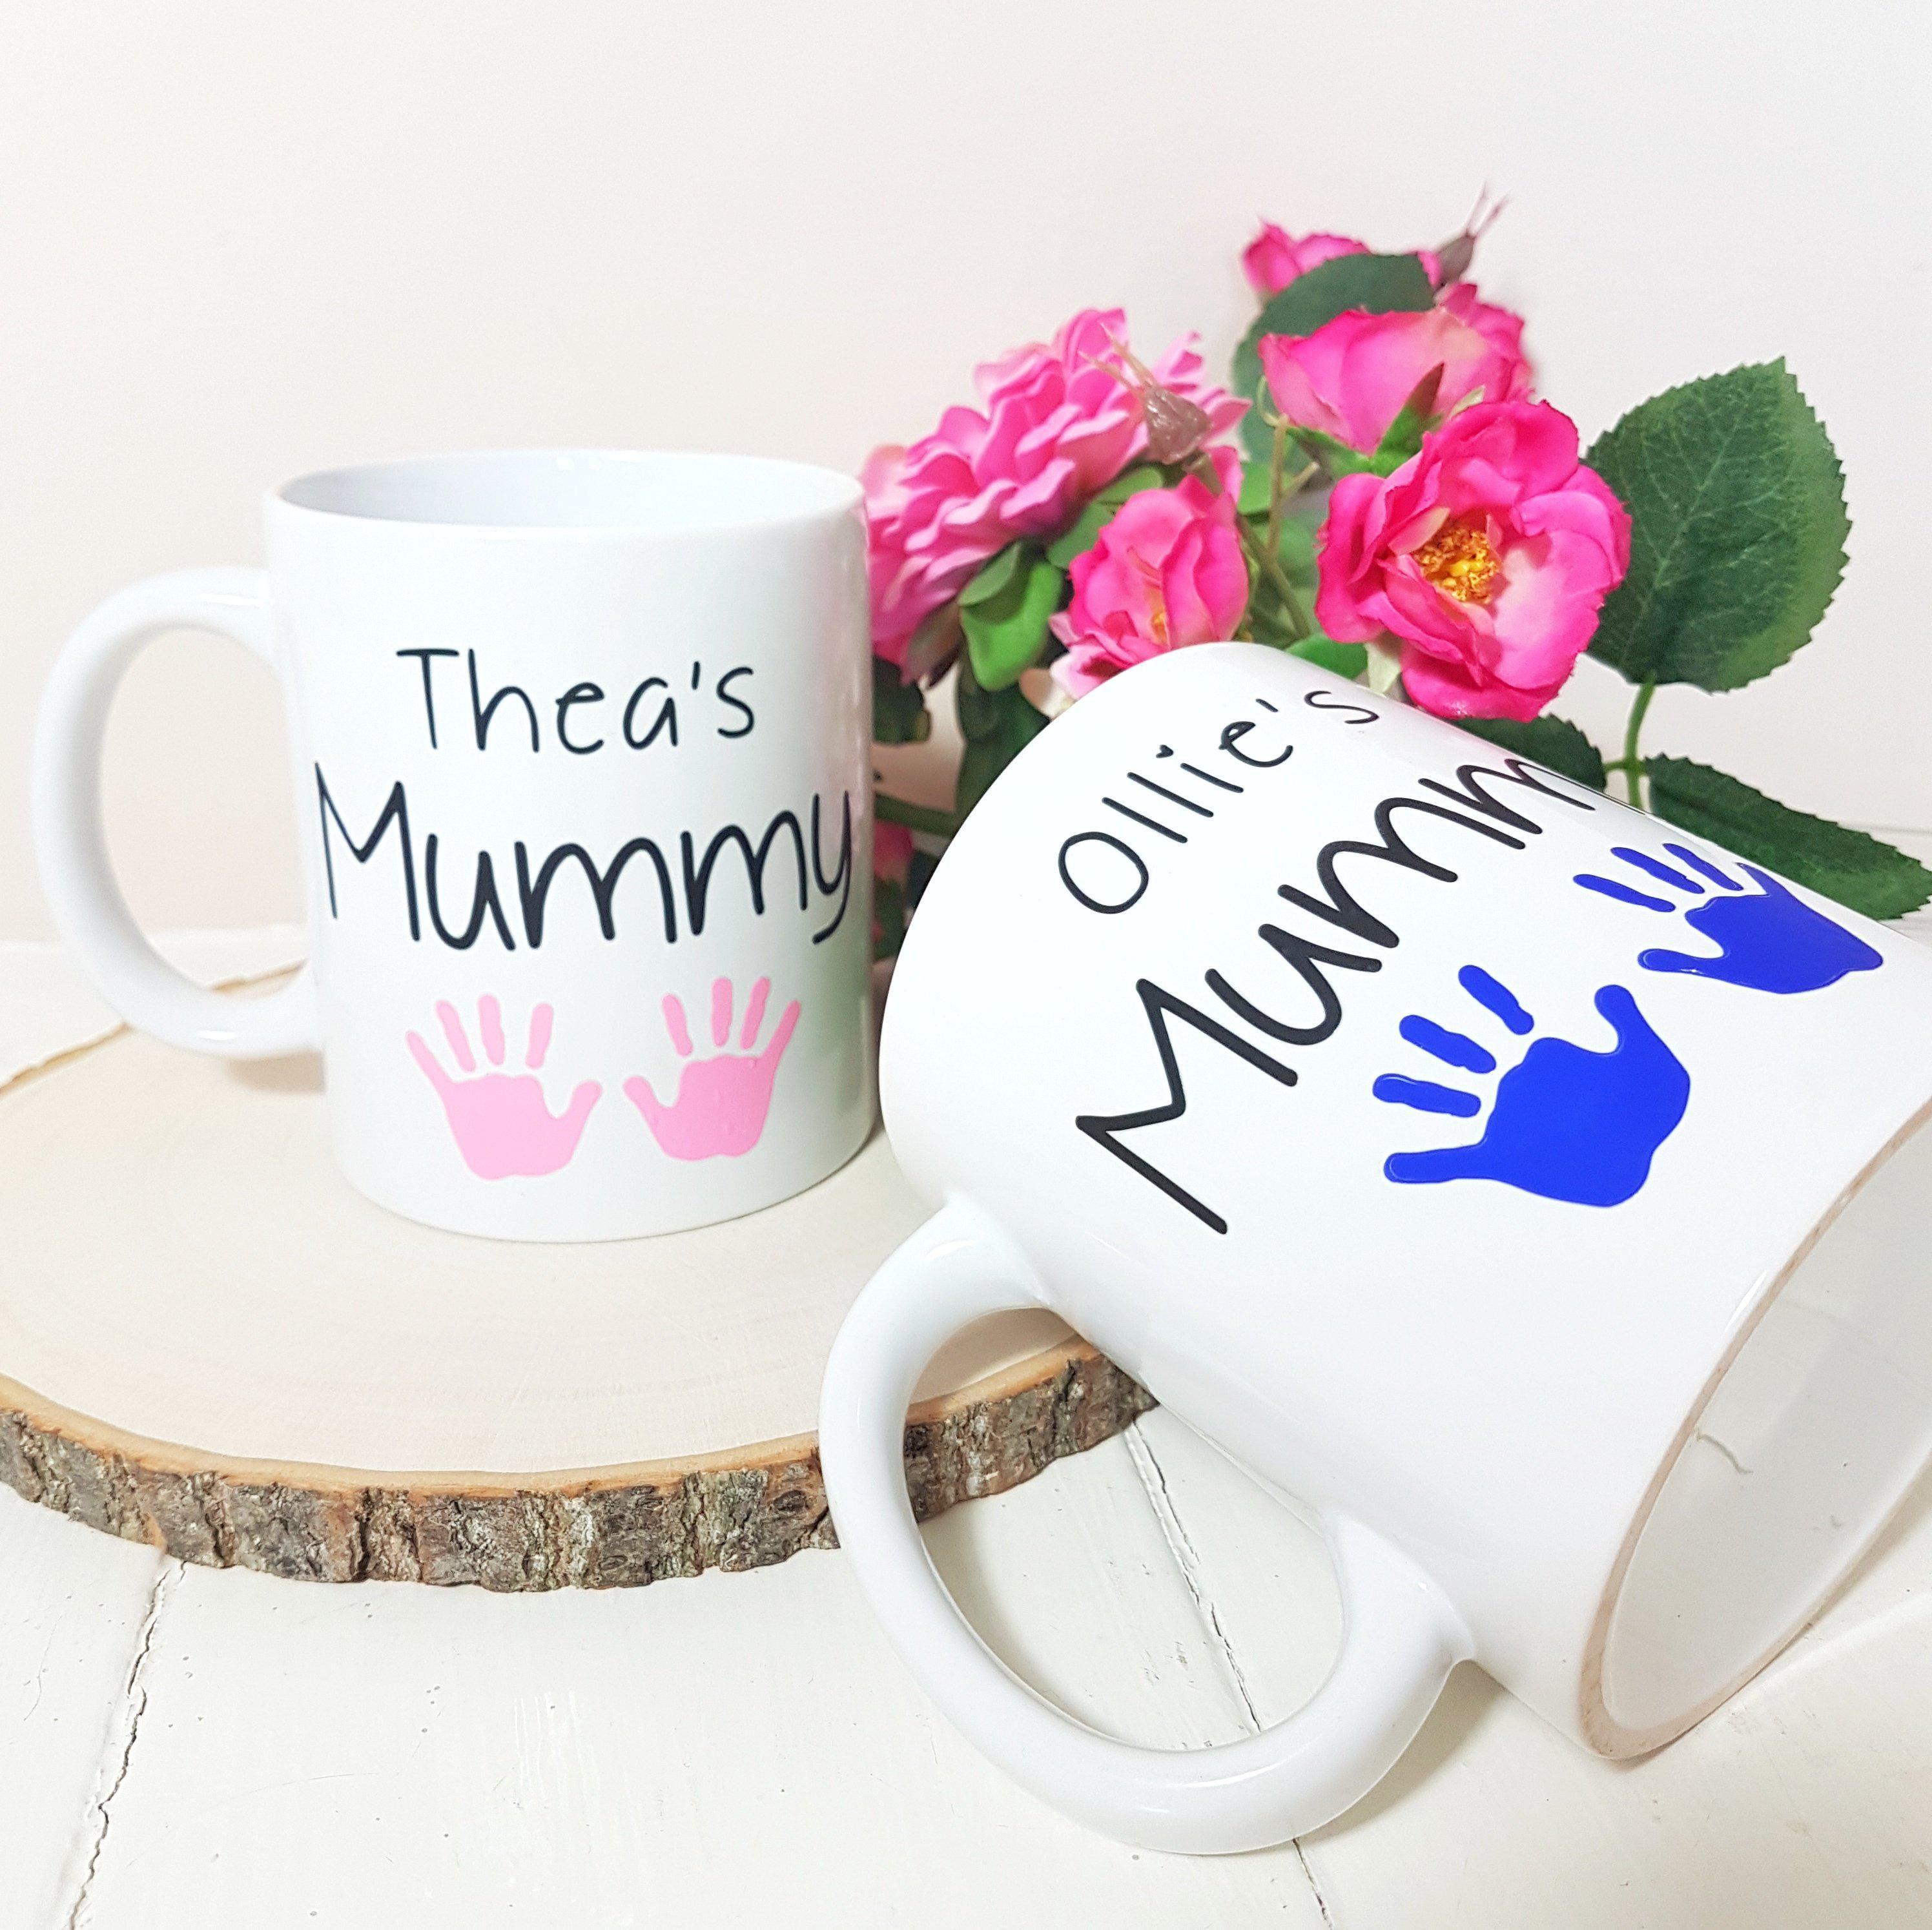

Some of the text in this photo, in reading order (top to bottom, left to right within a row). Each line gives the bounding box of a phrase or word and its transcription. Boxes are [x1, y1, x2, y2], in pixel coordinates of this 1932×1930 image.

[395, 648, 755, 755] Thea's
[1058, 690, 1380, 915] Ollie's
[314, 762, 852, 952] Mummy
[1074, 758, 1647, 1236] Mumm
